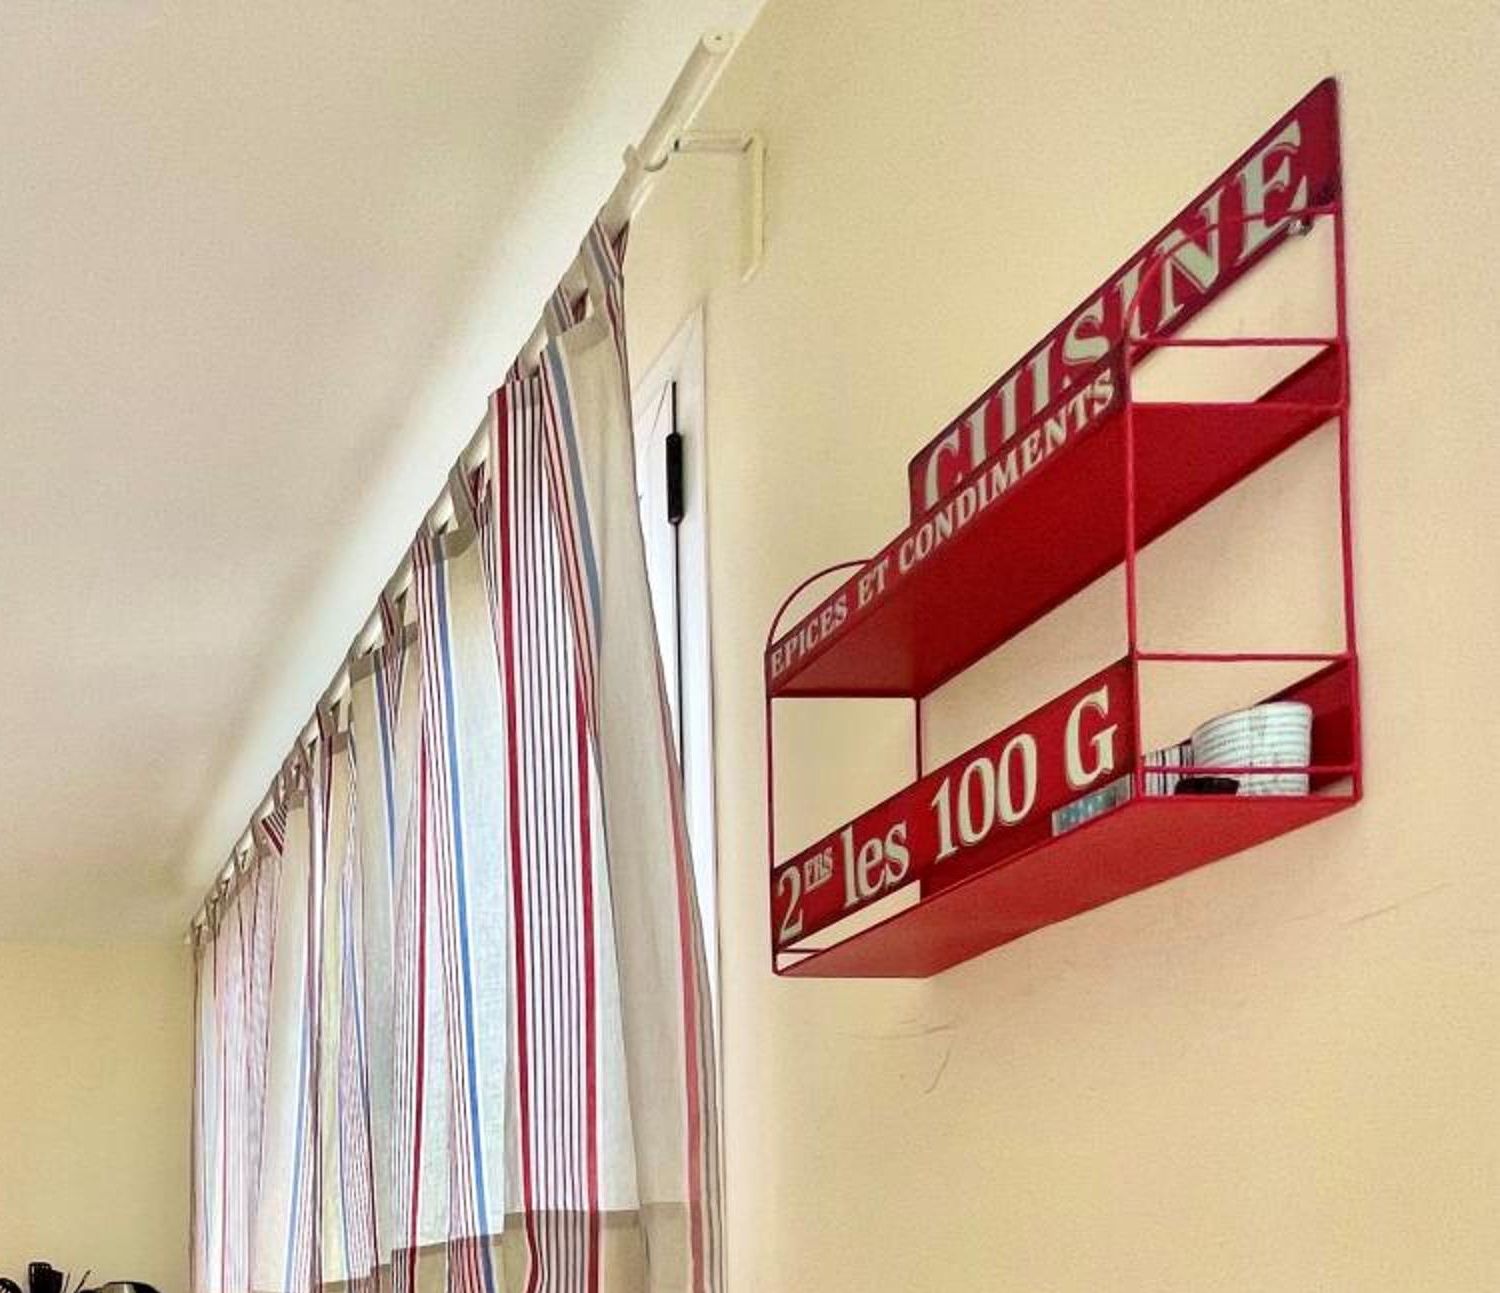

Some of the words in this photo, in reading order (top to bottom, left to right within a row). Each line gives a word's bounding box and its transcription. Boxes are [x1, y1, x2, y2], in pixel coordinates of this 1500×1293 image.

[924, 117, 1308, 508] CUISINE
[771, 594, 848, 680] EPICES
[858, 556, 889, 608] ET
[899, 367, 1115, 574] CONDIMENTS
[841, 824, 911, 909] les
[930, 733, 1038, 864] 100
[1064, 685, 1119, 791] G
